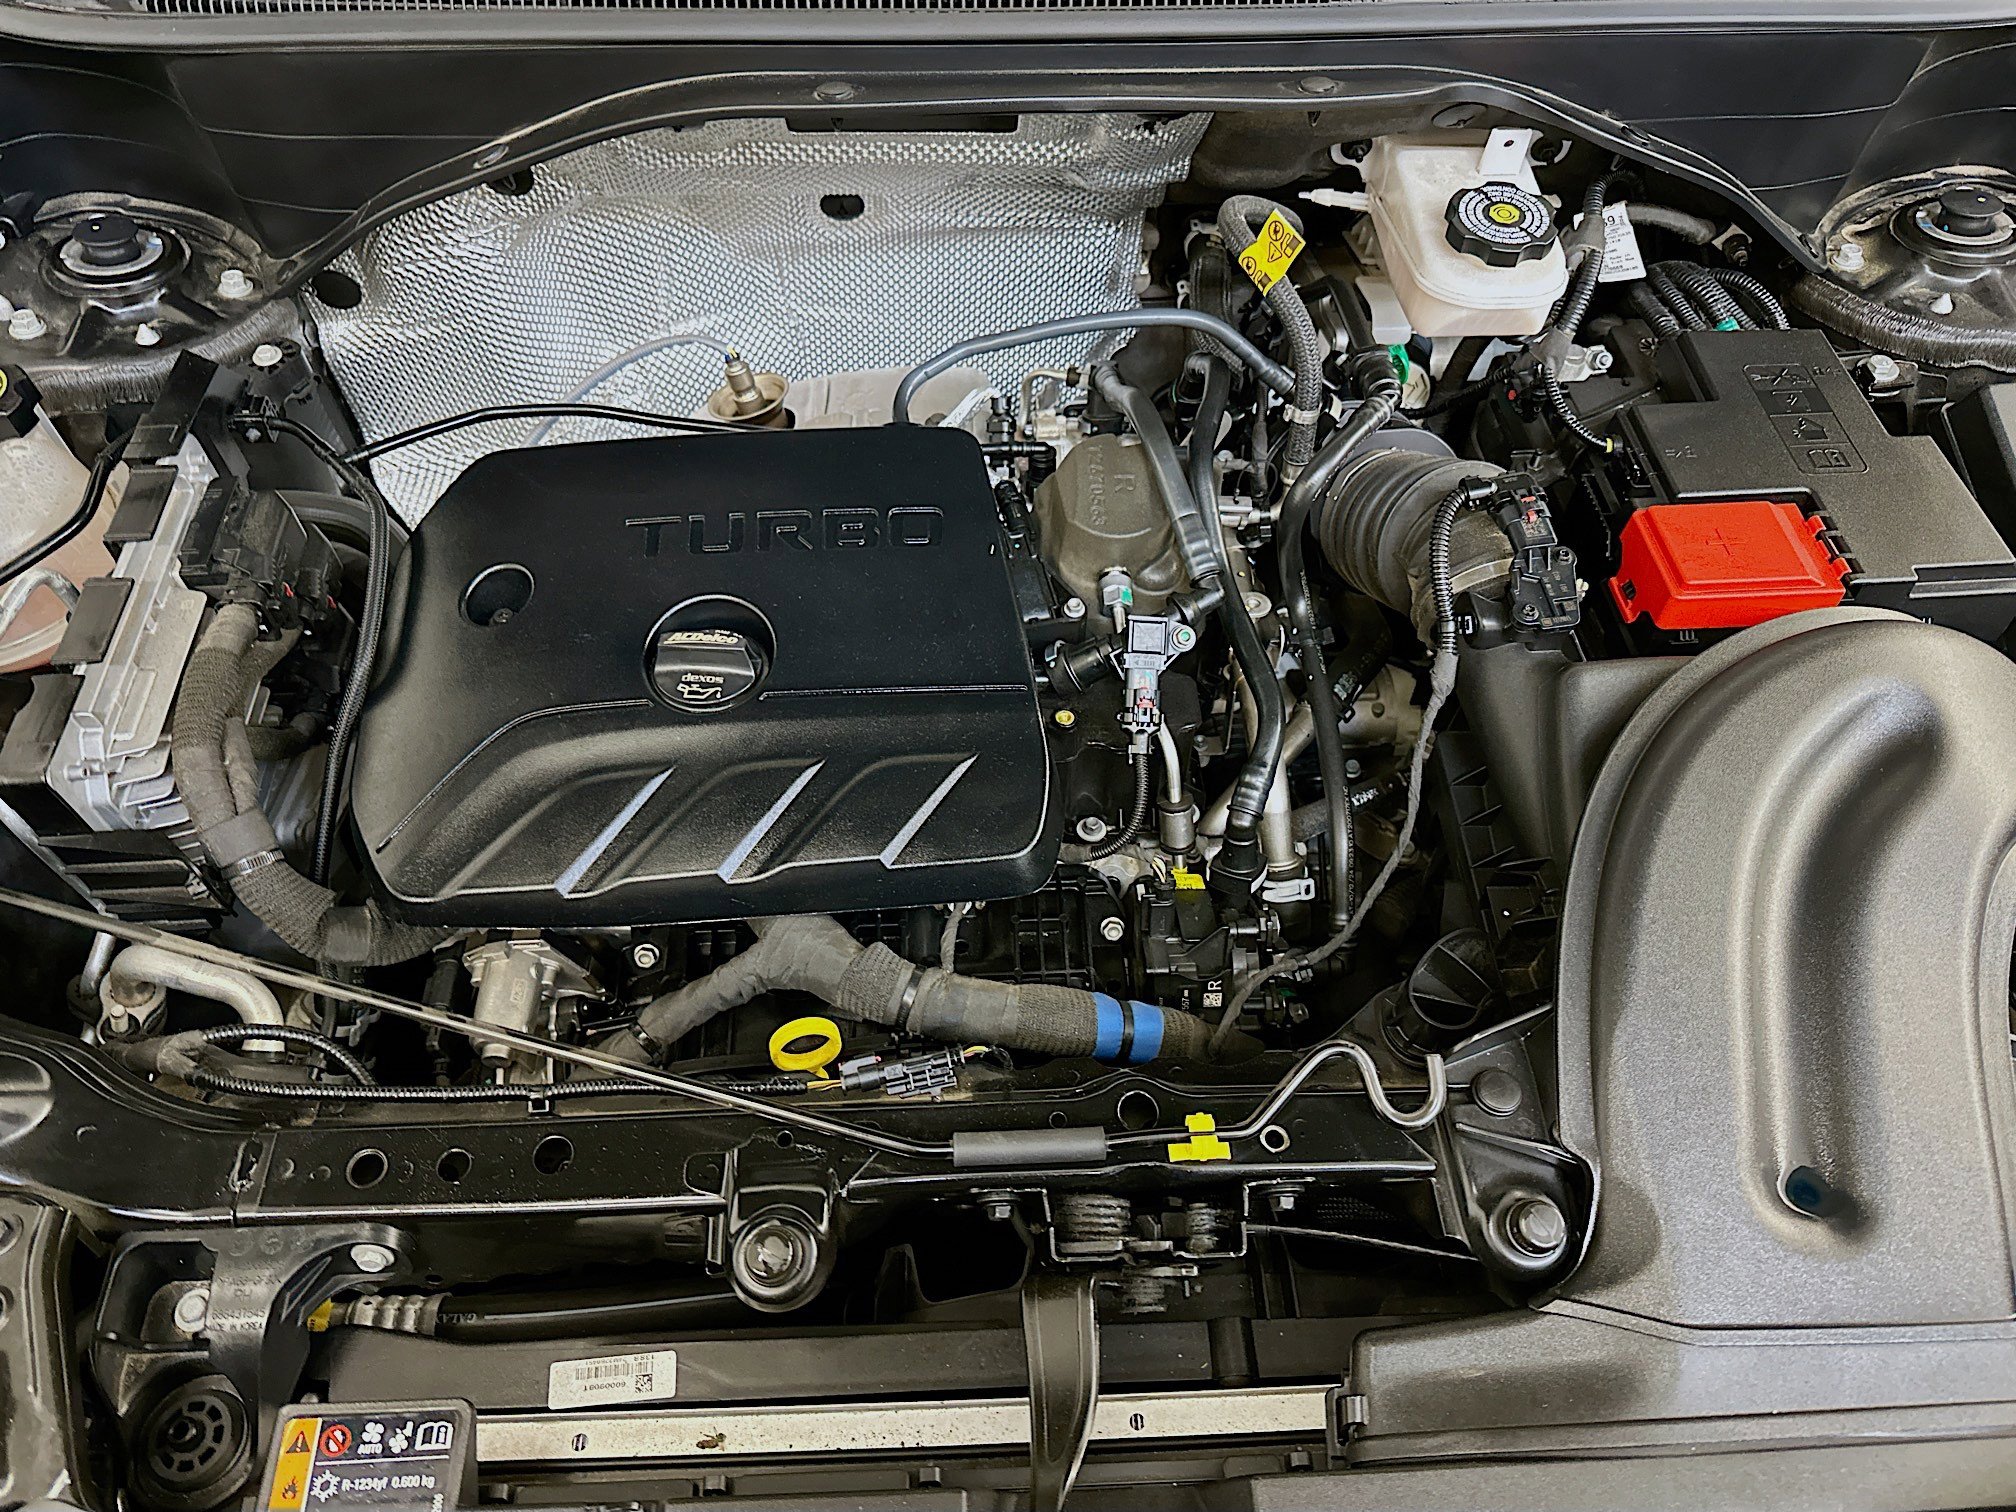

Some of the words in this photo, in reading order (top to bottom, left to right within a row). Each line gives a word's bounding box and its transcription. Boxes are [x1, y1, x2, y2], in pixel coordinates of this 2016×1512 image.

[1114, 473, 1137, 493] R
[626, 507, 944, 559] TURBO
[664, 632, 739, 644] ACDelco
[681, 672, 725, 684] dexos
[1207, 980, 1222, 991] R
[357, 1442, 383, 1456] AUTO
[341, 1476, 388, 1492] R-1234yf
[391, 1476, 421, 1490] 0.600
[421, 1475, 436, 1490] kg
